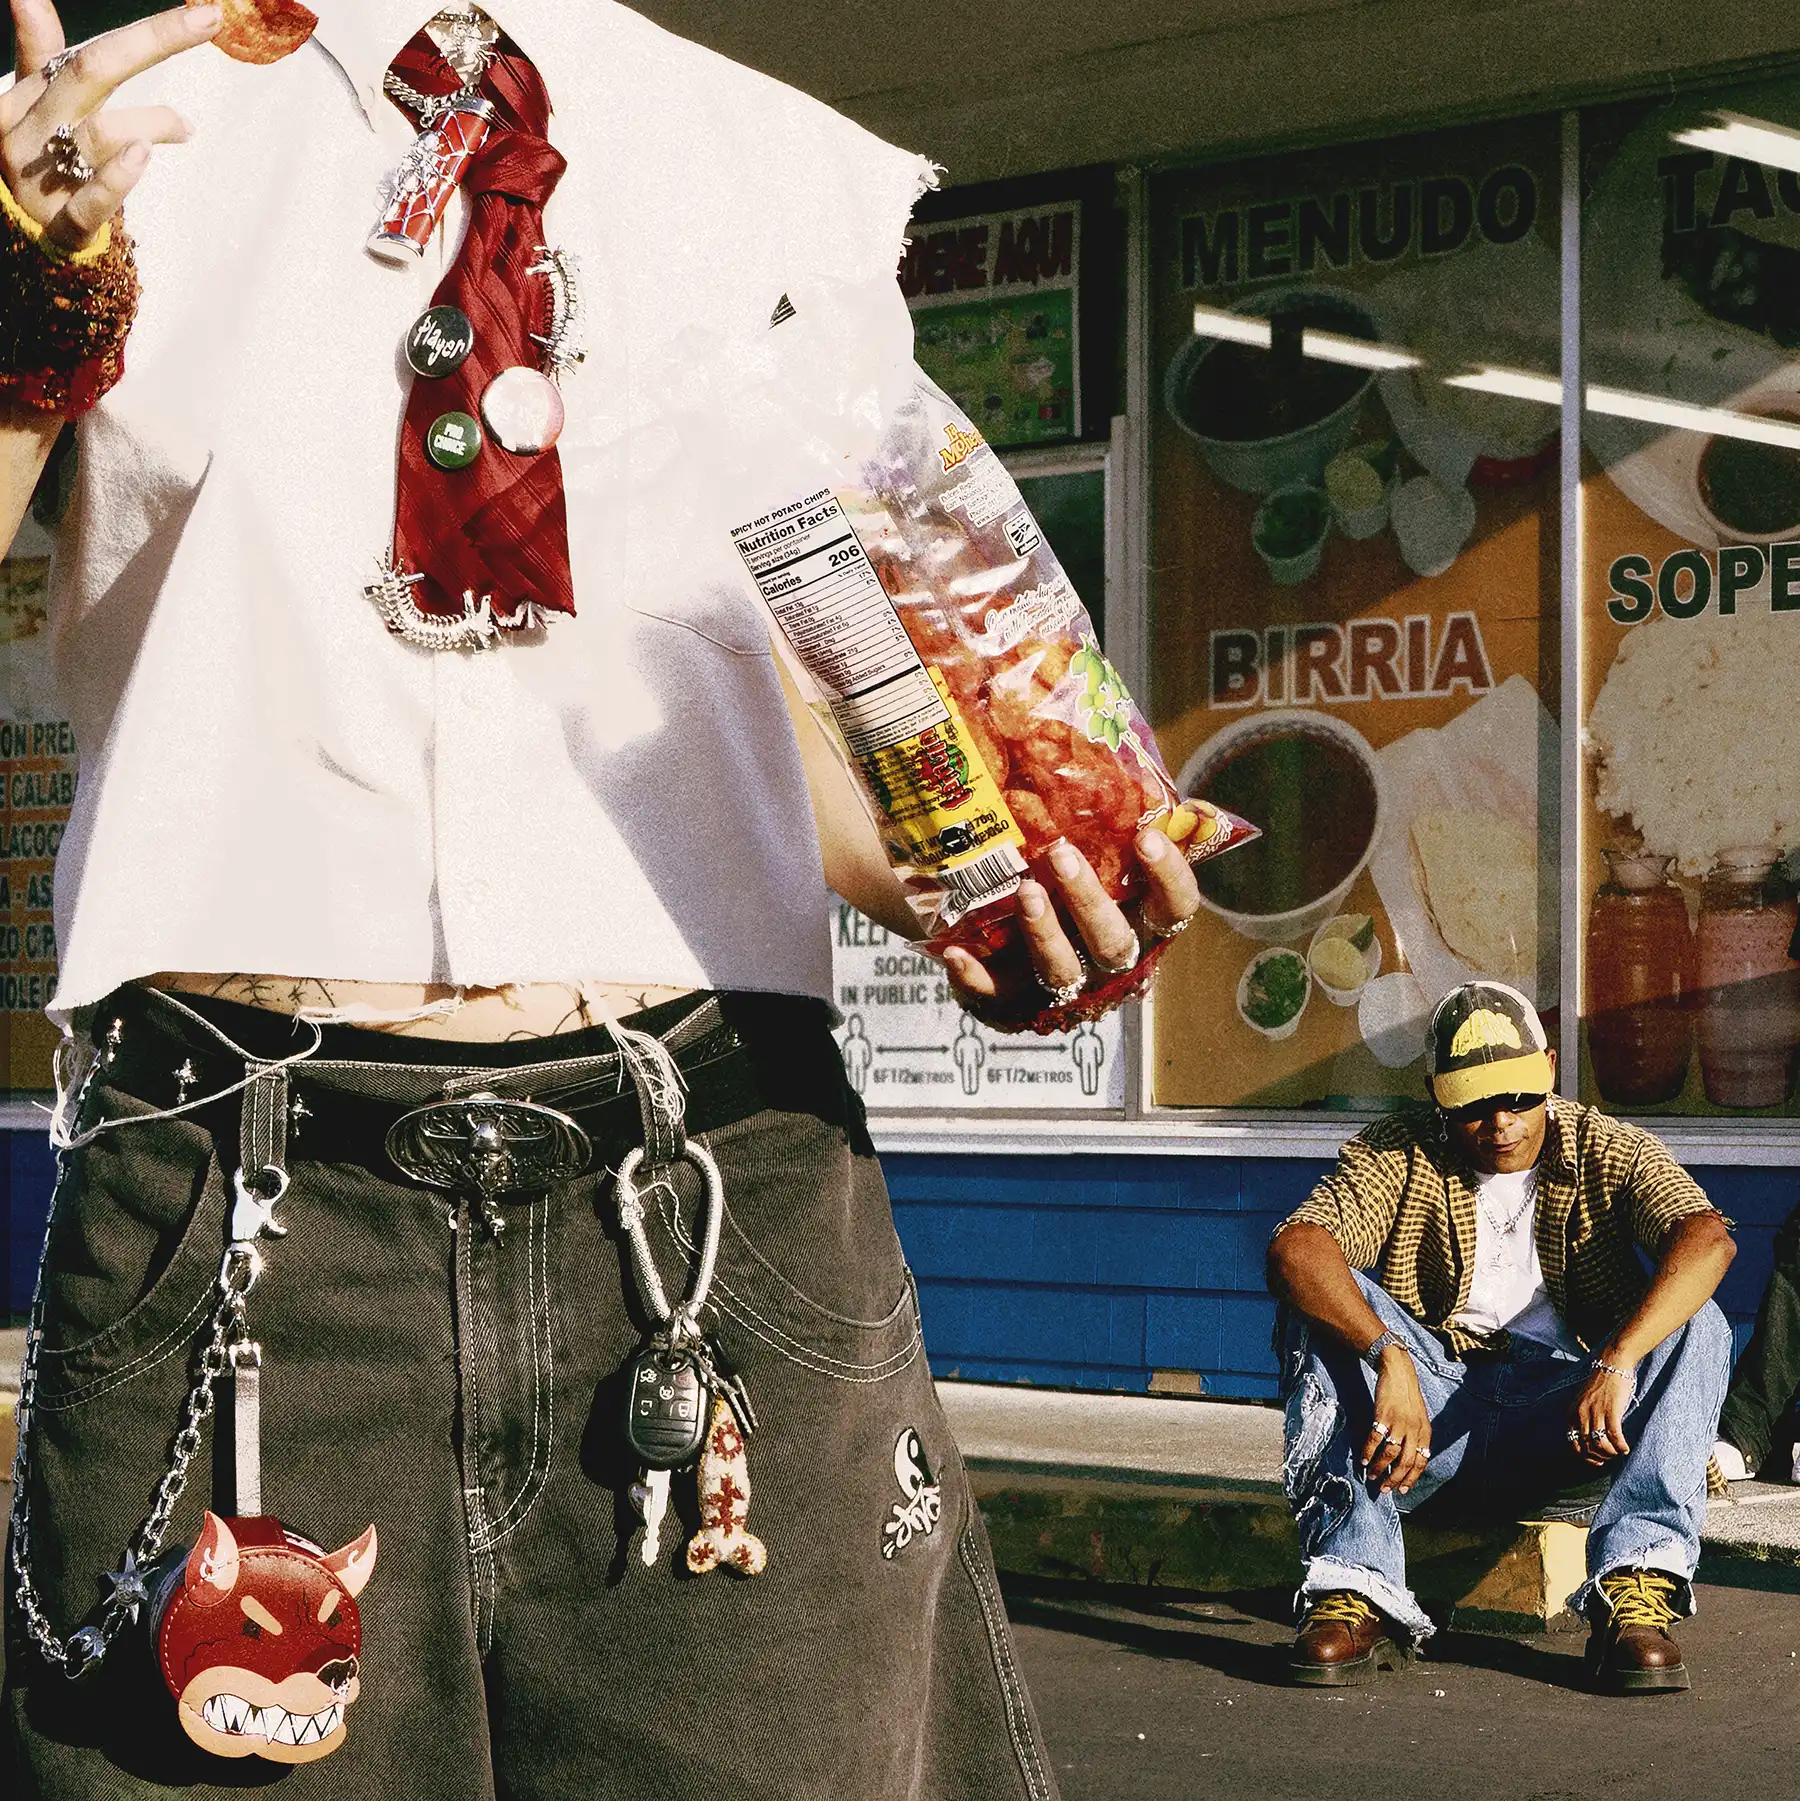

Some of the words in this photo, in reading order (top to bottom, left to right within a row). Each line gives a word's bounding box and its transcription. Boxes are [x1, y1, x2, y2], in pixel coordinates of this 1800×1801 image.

[1181, 165, 1538, 289] MENUDO
[414, 315, 465, 366] Player
[730, 523, 752, 537] SPICY
[754, 515, 770, 527] HOT
[772, 502, 803, 520] POTATO
[804, 488, 831, 506] CHIPS
[738, 524, 796, 554] Nutrition
[797, 505, 838, 529] Facts
[763, 575, 802, 596] Calories
[828, 545, 860, 567] 206
[1208, 611, 1494, 710] BIRRIA
[12, 773, 79, 807] CALAB
[842, 986, 857, 1005] IN
[864, 983, 927, 1005] PUBLIC
[934, 982, 950, 1005] S
